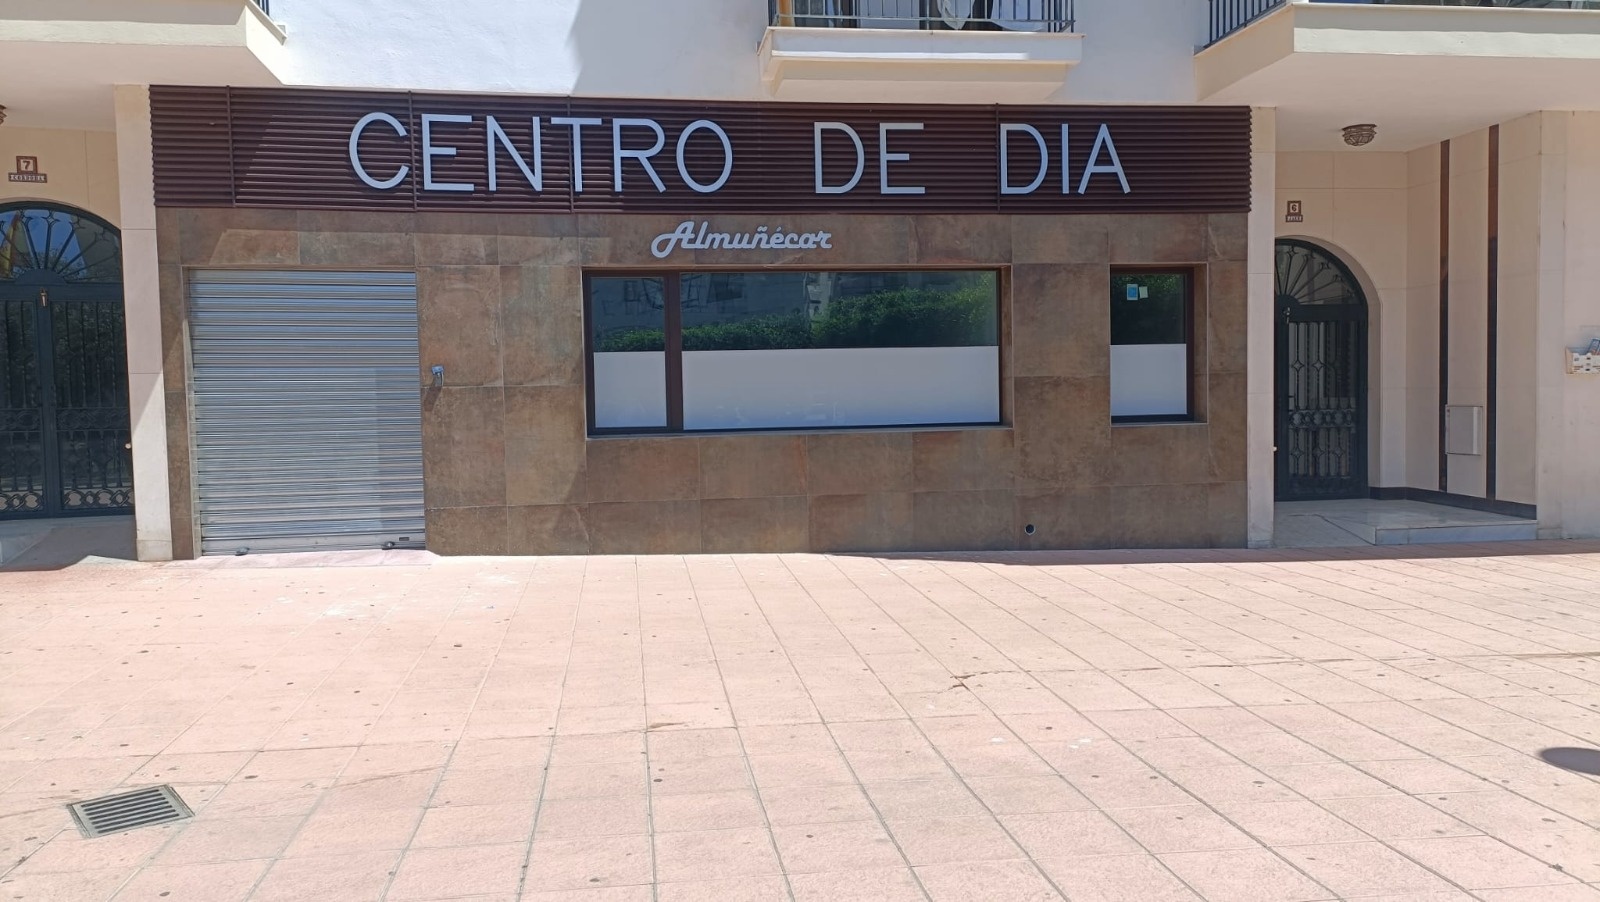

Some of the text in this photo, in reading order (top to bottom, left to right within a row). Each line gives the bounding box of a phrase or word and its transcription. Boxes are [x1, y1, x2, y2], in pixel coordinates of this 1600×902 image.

[349, 111, 1131, 195] CENTRO DE DIA
[22, 160, 31, 170] 7
[1291, 204, 1298, 212] 6
[651, 221, 832, 258] Almuñécar
